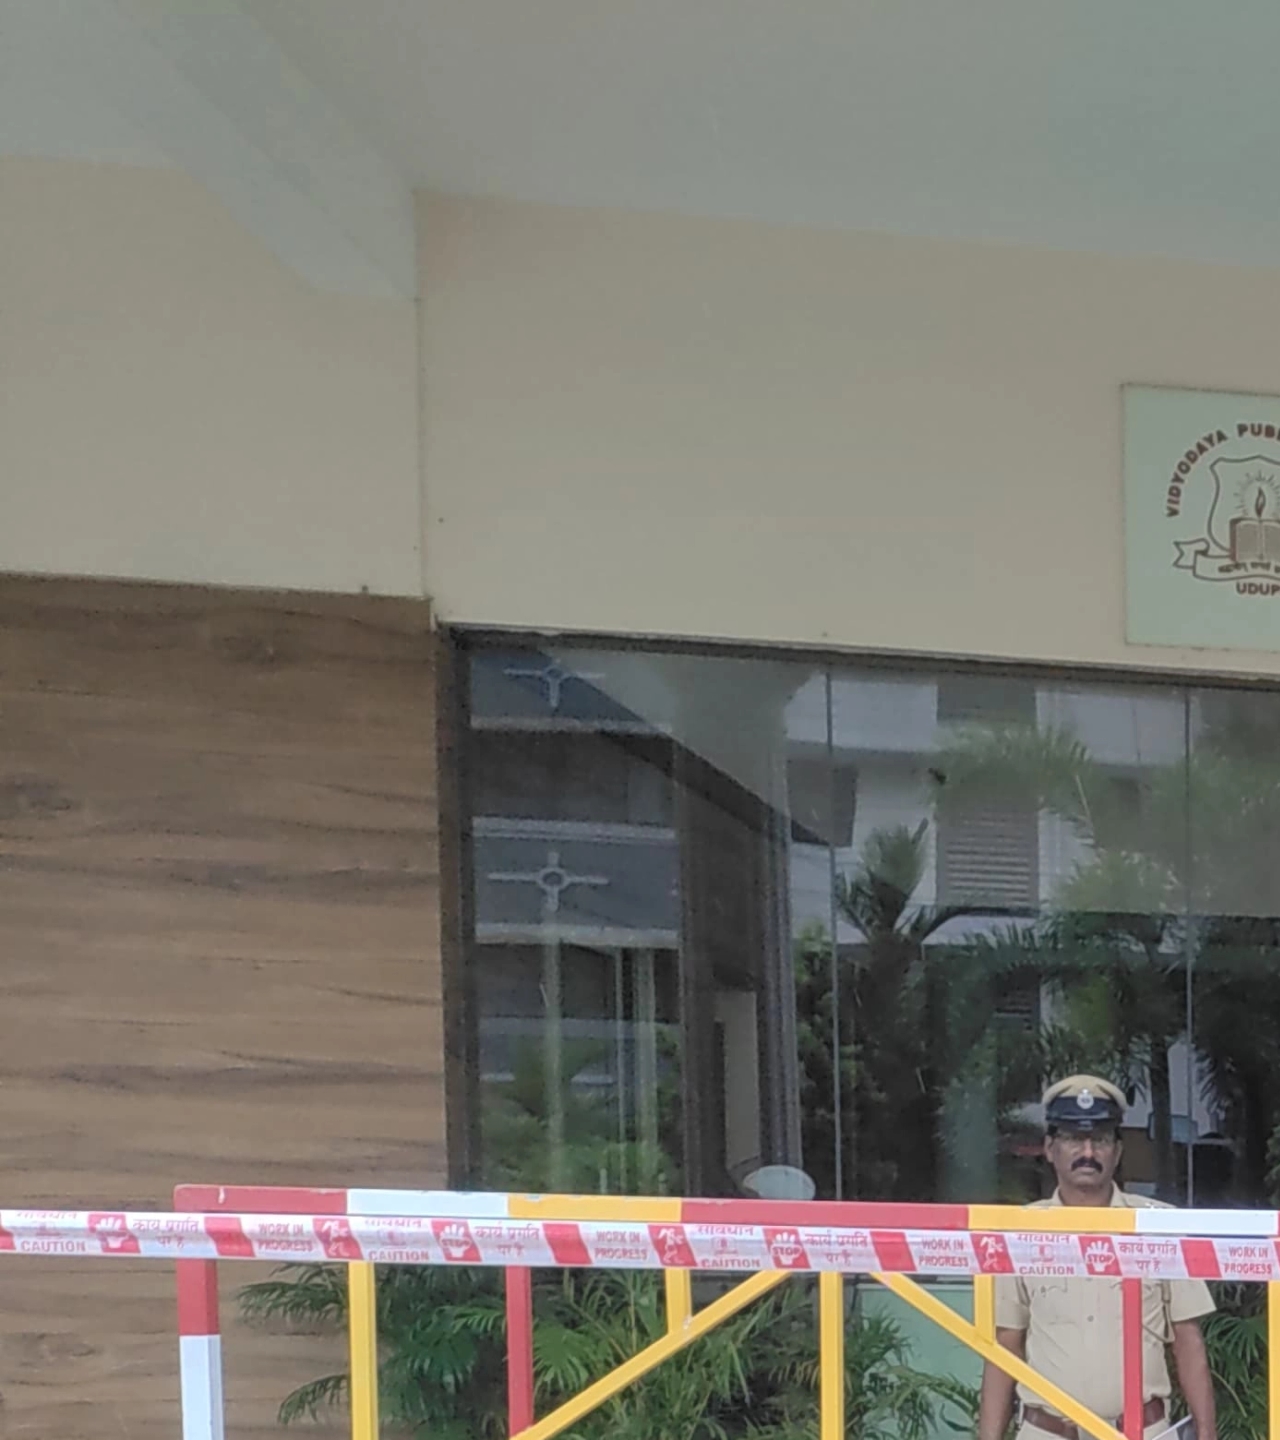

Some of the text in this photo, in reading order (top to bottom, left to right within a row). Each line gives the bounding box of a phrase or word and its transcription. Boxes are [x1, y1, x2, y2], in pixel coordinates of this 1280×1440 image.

[1167, 430, 1228, 517] VIDYODAYA
[772, 1245, 800, 1255] STOP
[1229, 1247, 1268, 1258] WORK IN
[919, 1255, 969, 1268] PROGRESS
[1087, 1253, 1111, 1263] STOP
[1019, 1266, 1075, 1275] CAUTION
[1224, 1263, 1272, 1275] PROGRESS
